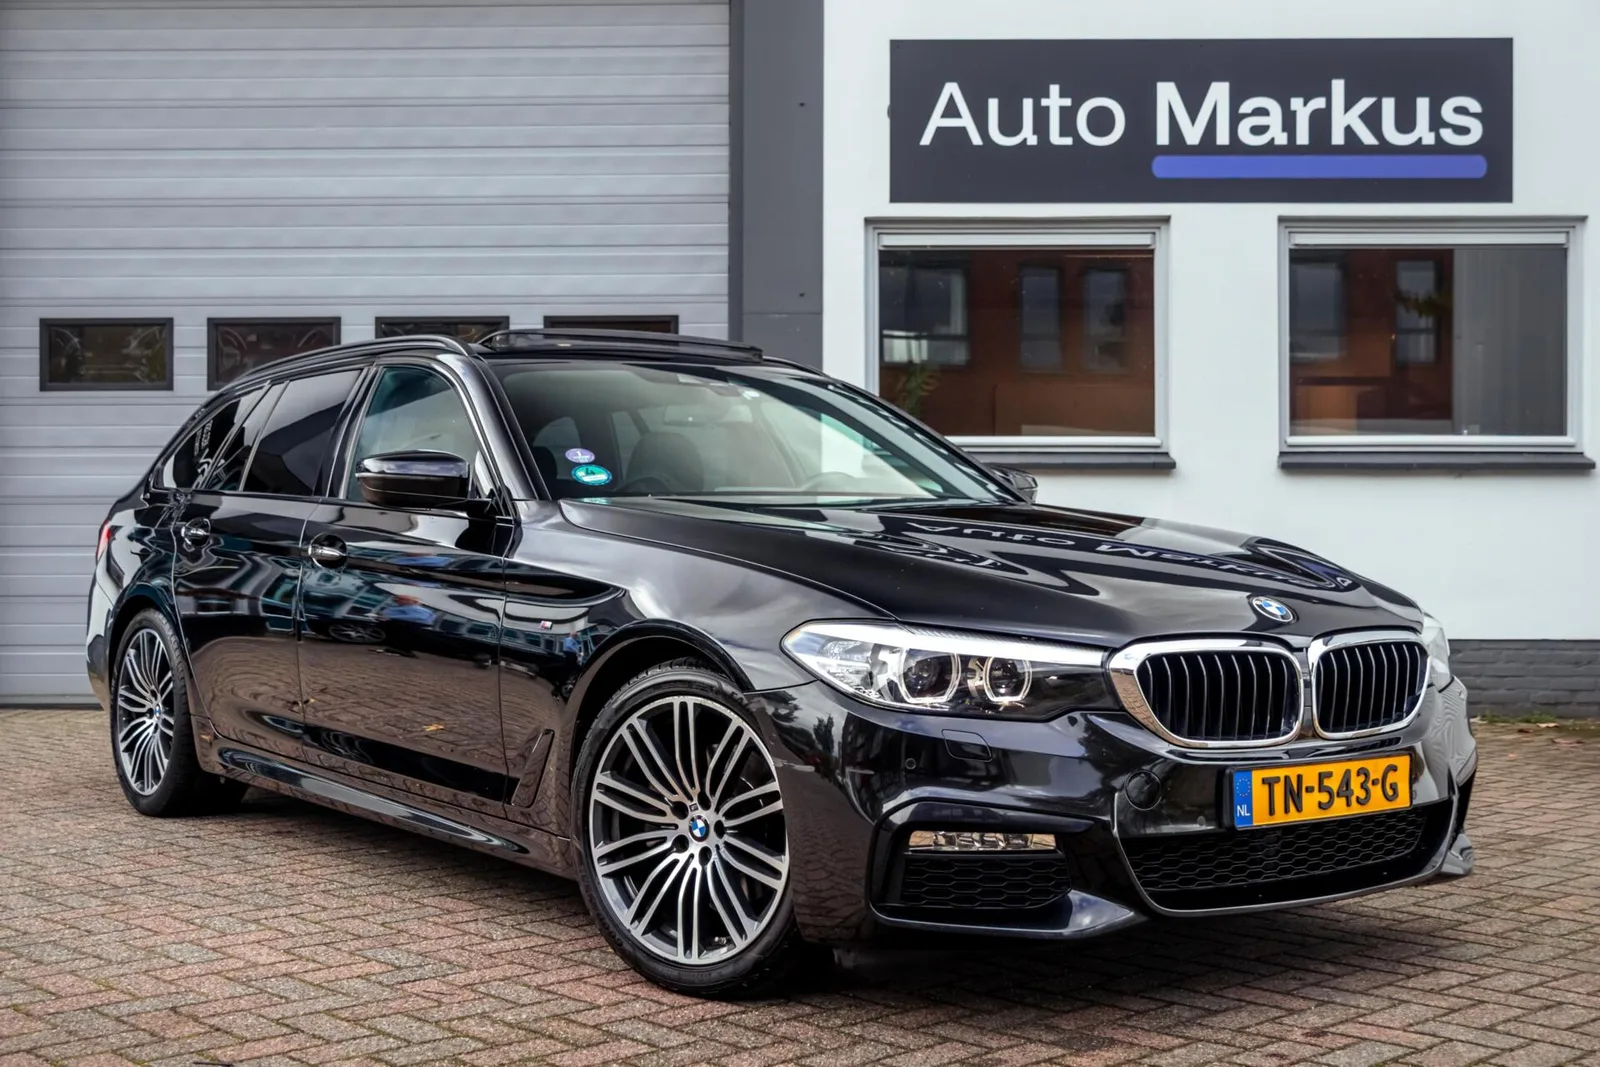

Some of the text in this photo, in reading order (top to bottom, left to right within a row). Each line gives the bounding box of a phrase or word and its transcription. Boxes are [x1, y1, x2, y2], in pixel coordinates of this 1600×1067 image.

[919, 79, 1483, 146] Auto Markus
[1237, 805, 1250, 816] NL
[1262, 764, 1398, 816] TN-543-G
